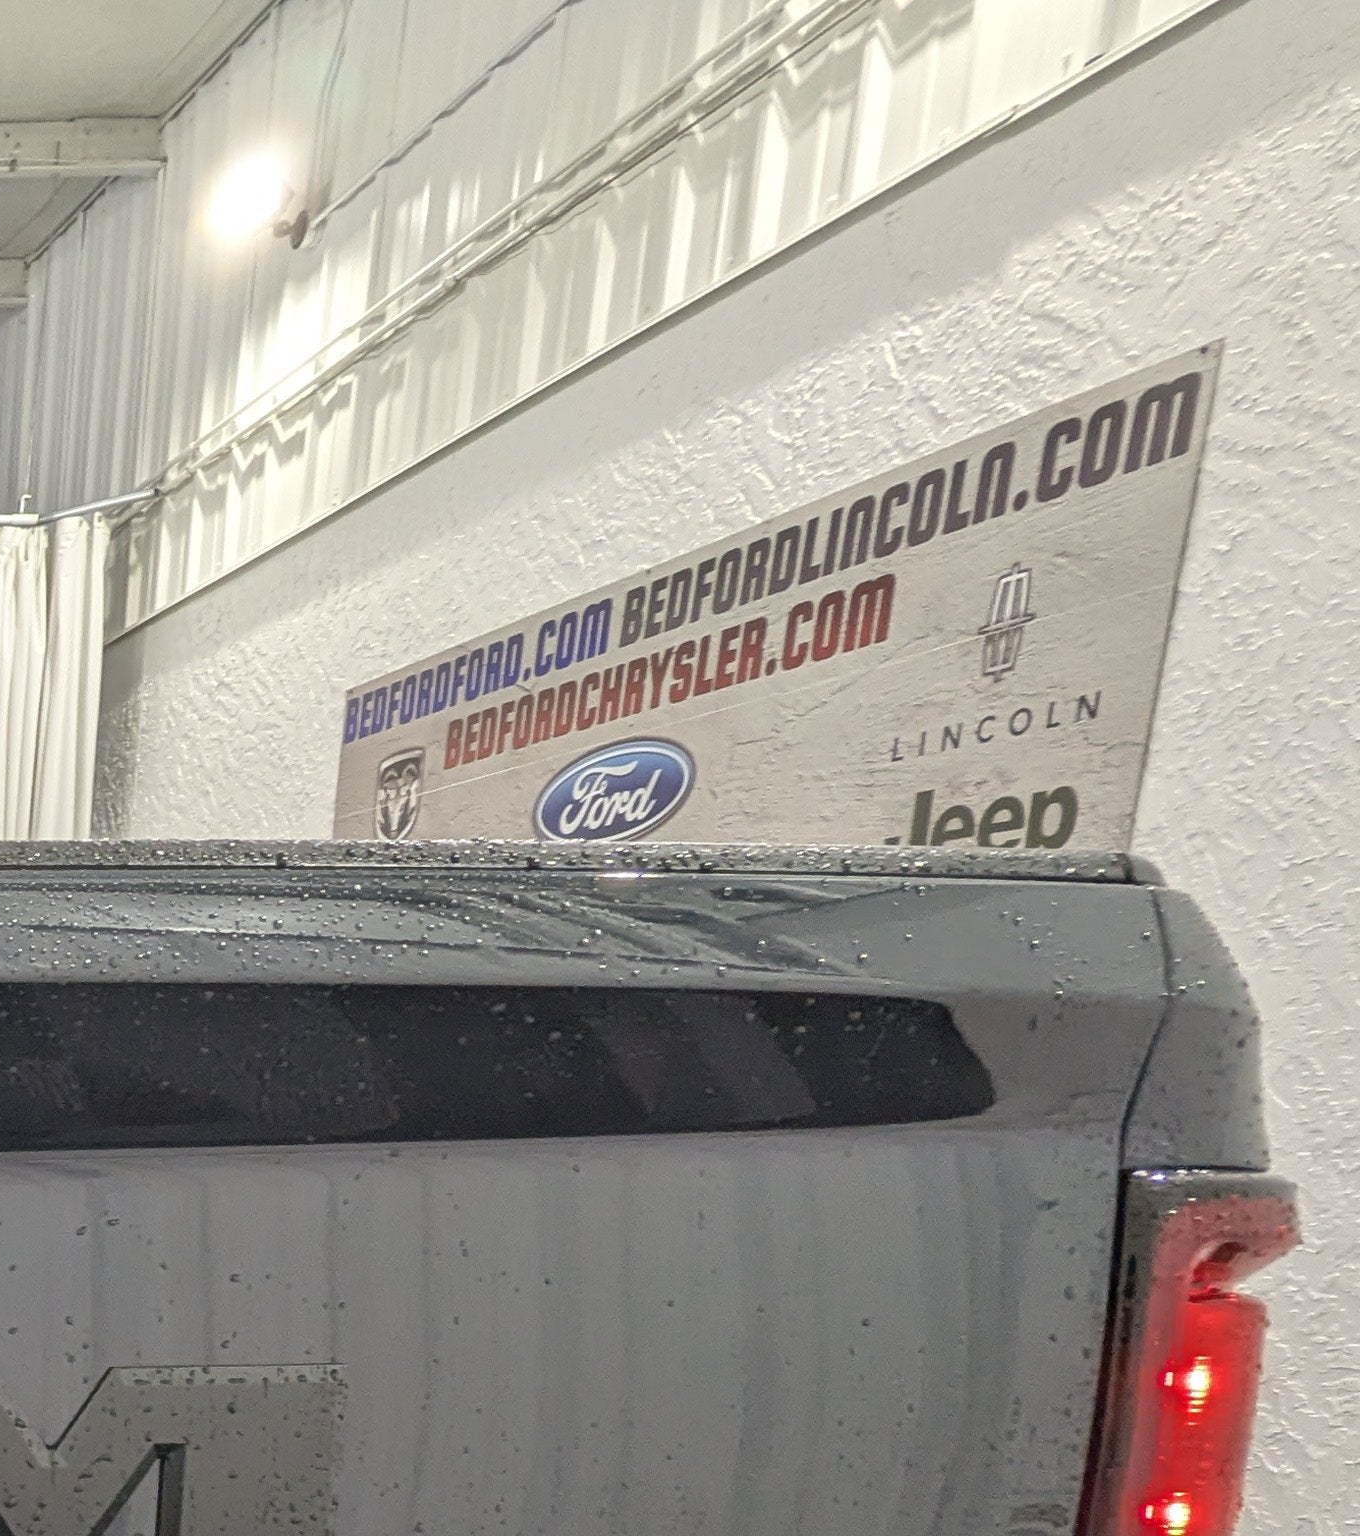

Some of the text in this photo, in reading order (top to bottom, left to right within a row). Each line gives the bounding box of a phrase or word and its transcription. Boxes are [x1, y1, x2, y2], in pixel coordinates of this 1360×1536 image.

[343, 371, 1203, 745] BEDFORDFORD.COM BEDFORDLINCOLN.COM
[444, 573, 896, 769] BEDFORDCHRYSLER.COM
[890, 691, 1102, 763] LINCOLN
[559, 760, 663, 835] Ford
[884, 785, 1079, 849] Jeep
